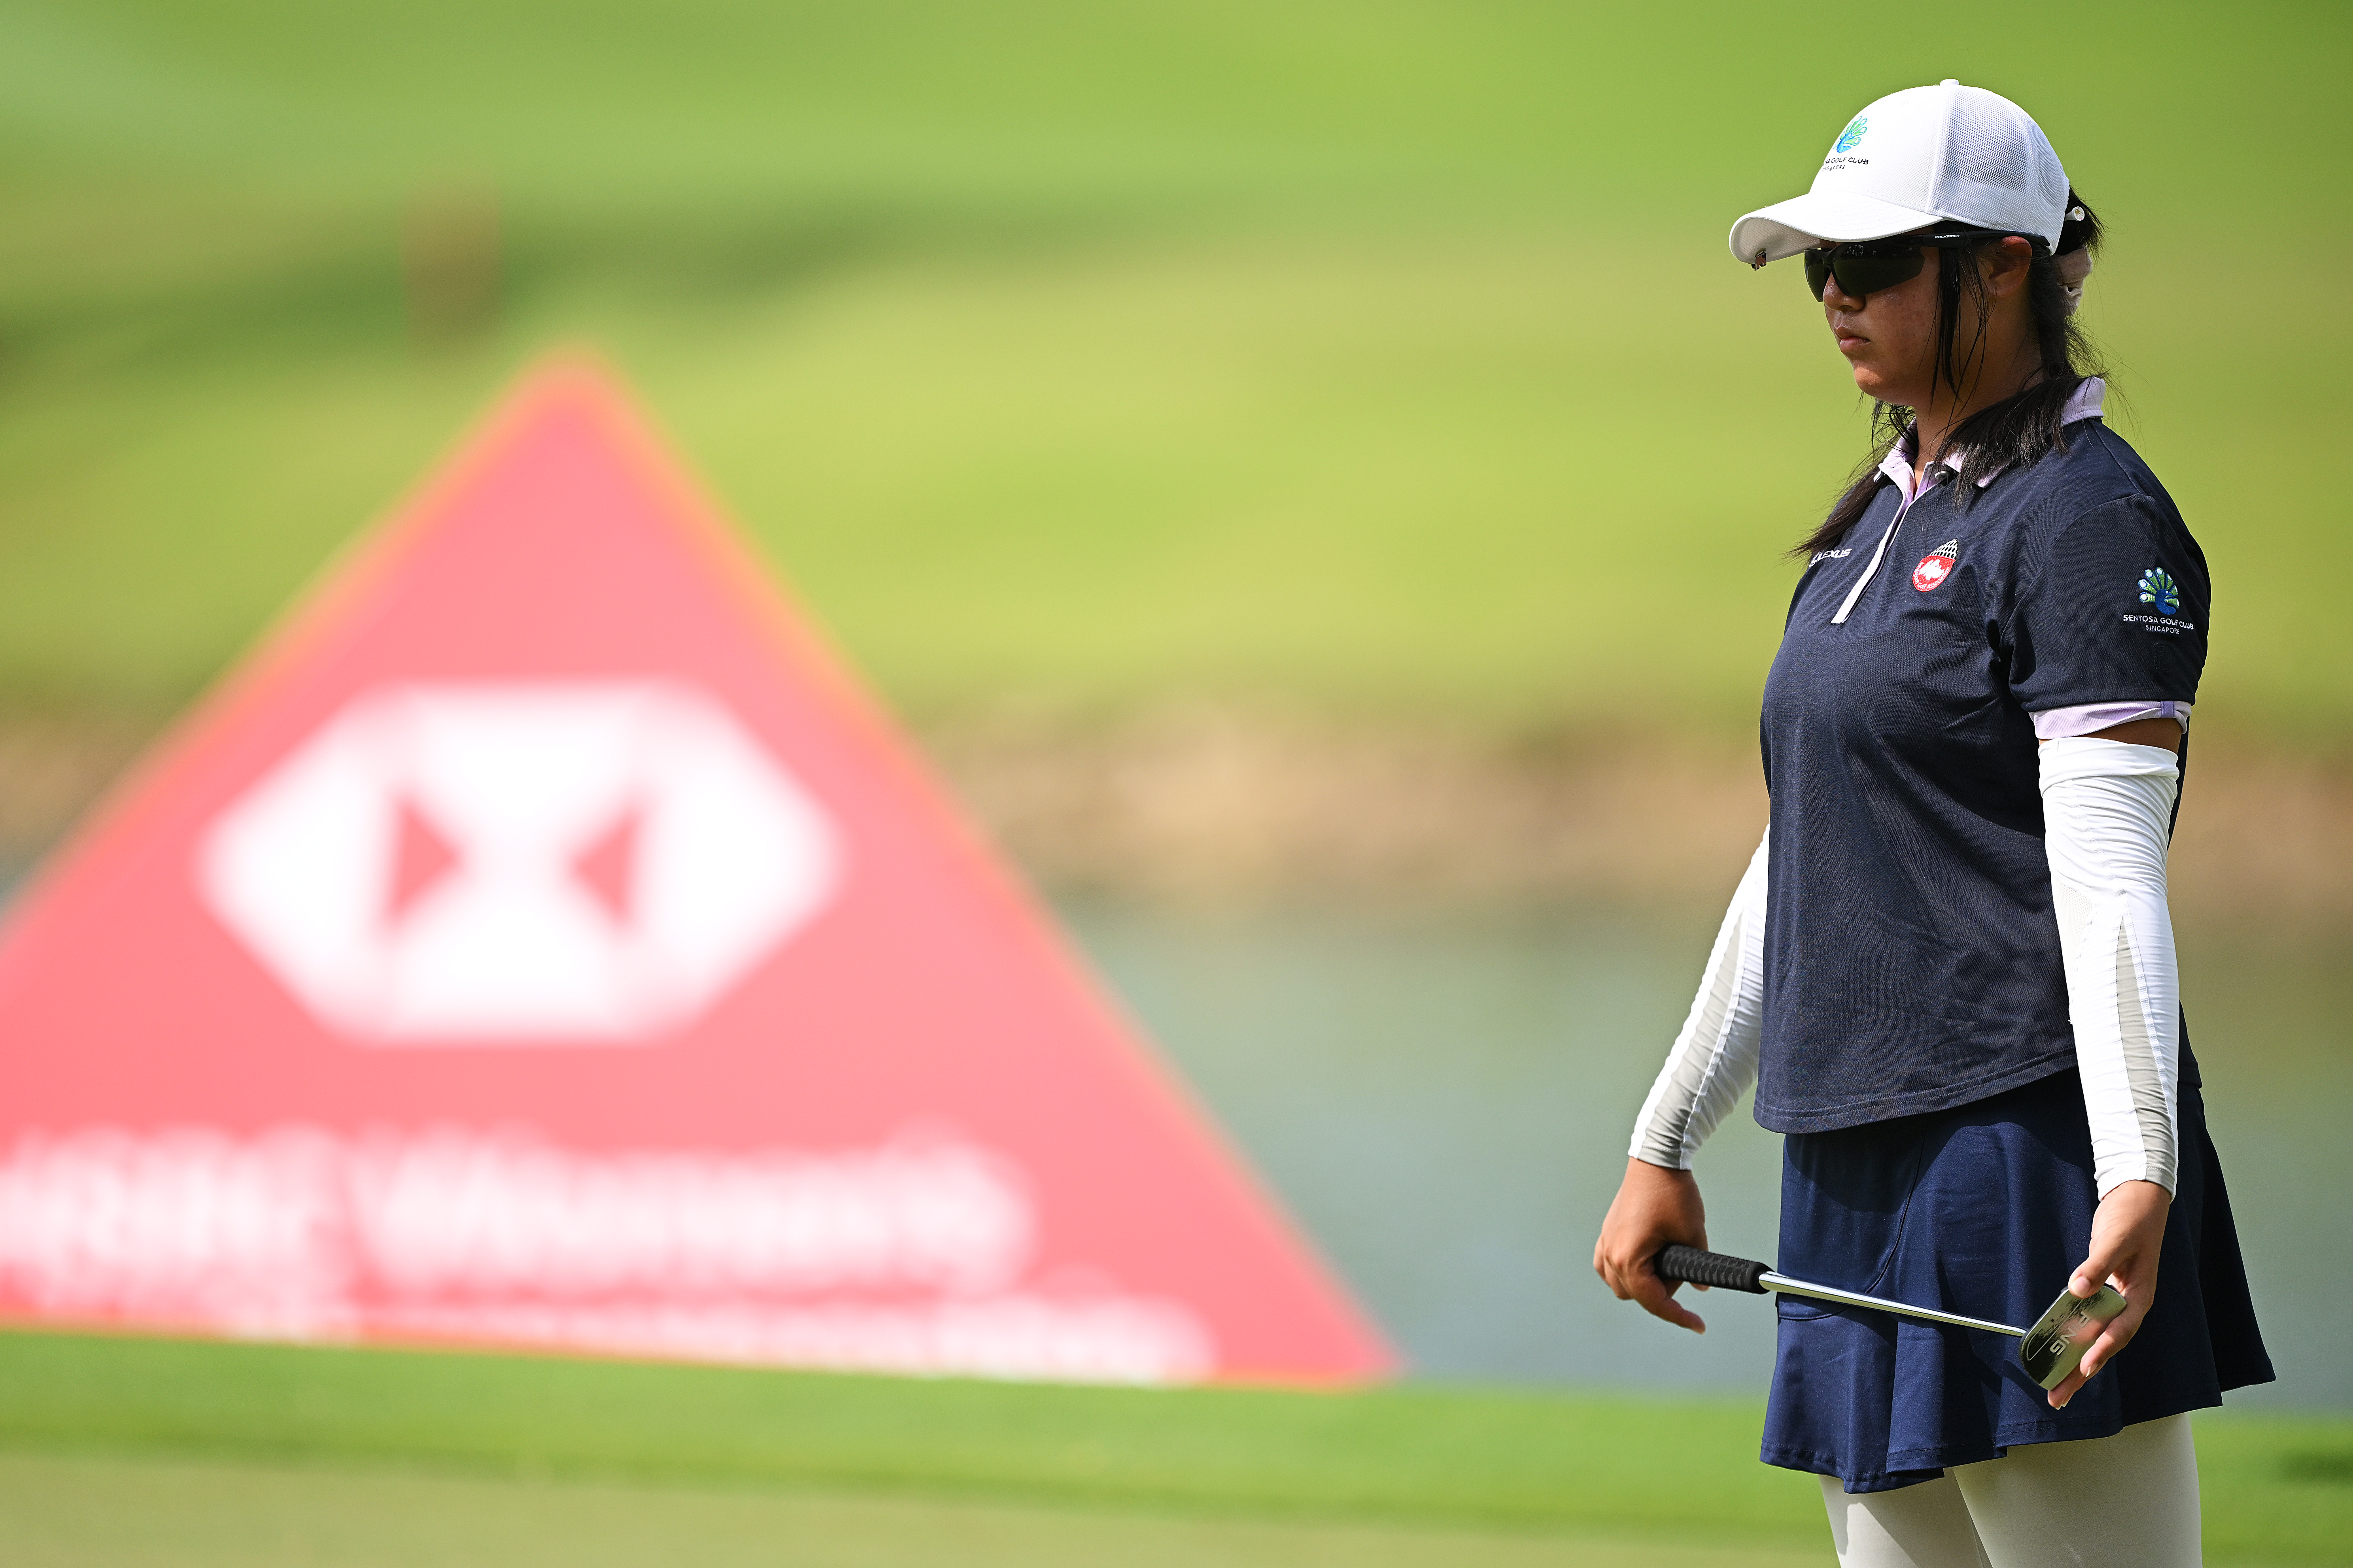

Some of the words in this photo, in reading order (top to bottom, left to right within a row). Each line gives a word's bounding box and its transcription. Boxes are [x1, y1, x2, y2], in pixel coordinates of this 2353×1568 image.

[1926, 567, 1950, 590] Association
[2123, 614, 2158, 624] SENTOSA
[2160, 617, 2179, 627] GOLF
[2179, 621, 2194, 630] CLUB
[2145, 625, 2180, 635] SINGAPORE
[2050, 1311, 2090, 1356] PING
